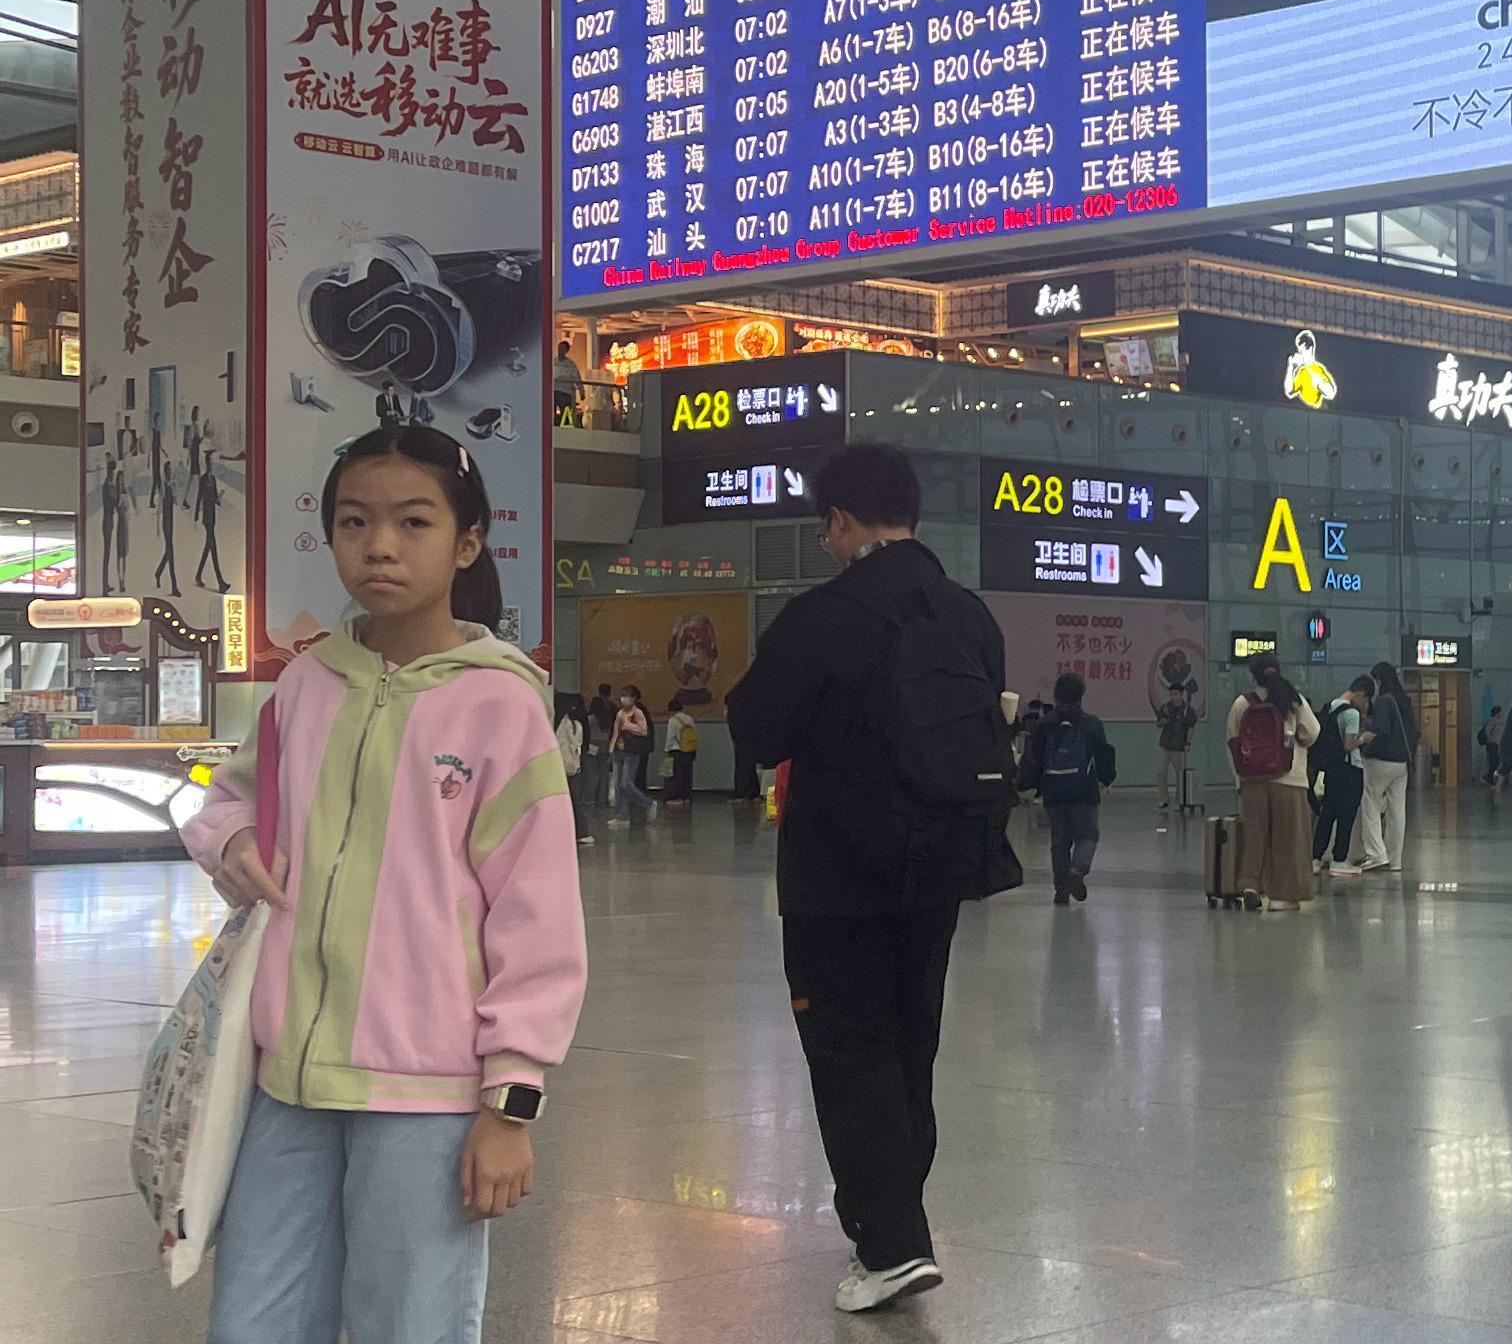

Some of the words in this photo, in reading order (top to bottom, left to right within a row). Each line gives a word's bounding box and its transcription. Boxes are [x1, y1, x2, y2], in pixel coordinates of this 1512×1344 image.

[571, 46, 619, 79] G6203
[645, 25, 705, 65] 深圳北
[735, 9, 788, 43] 07:02
[576, 9, 615, 41] D927
[572, 122, 620, 154] C6903
[646, 104, 705, 143] 湛江西
[735, 89, 788, 123] 07:05
[1079, 10, 1180, 60] 正在候车
[572, 84, 620, 117] G1748
[645, 64, 705, 103] 蚌埠南
[735, 49, 788, 83] 07:02
[283, 58, 529, 154] 就选移动云
[572, 160, 620, 192] D7133
[735, 130, 788, 163] 07:07
[1080, 55, 1180, 104] 正在候车
[572, 198, 620, 230] G1002
[735, 170, 789, 202] 07:07
[1080, 100, 1181, 148] 正在候车
[572, 237, 621, 270] C7217
[735, 210, 789, 242] 07:10
[1080, 145, 1181, 192] 正在候车
[603, 265, 643, 287] China
[928, 215, 997, 241] Service
[1034, 283, 1082, 316] 真功夫
[672, 389, 732, 433] A28
[737, 386, 781, 412] 检票口
[745, 412, 772, 426] Check
[772, 410, 781, 424] in
[705, 468, 749, 492] 卫生间
[705, 494, 749, 508] Restrooms
[993, 471, 1064, 516] A28
[1071, 477, 1124, 505] 检票口
[1073, 504, 1104, 519] Check
[1104, 506, 1113, 520] in
[1034, 539, 1088, 567] 卫生间
[1253, 497, 1312, 592] A
[1324, 520, 1349, 561] 区
[1035, 566, 1088, 583] Restrooms
[1324, 566, 1362, 592] Area
[226, 598, 244, 668] 便民早餐
